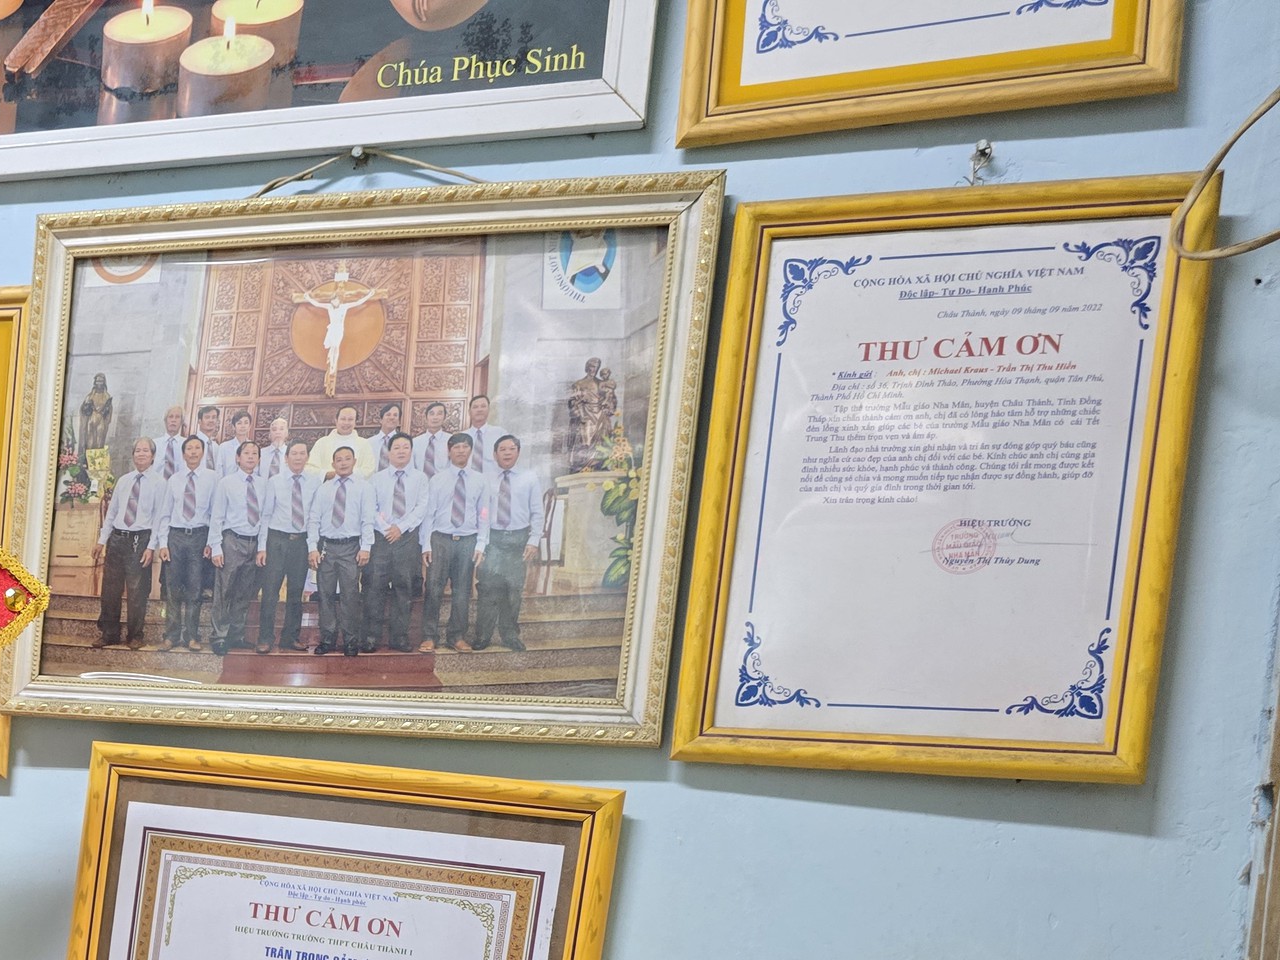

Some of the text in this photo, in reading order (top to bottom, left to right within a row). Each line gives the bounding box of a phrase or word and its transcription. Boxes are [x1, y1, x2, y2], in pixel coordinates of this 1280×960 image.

[376, 44, 586, 88] Chúa Phục Sinh
[853, 266, 1084, 288] CỘNG HÒA XÃ HỘI CHỦ NGHĨA VIỆT NAM
[899, 290, 918, 300] Độc
[941, 287, 955, 298] Tự
[1007, 283, 1032, 294] Phúc
[936, 303, 1103, 318] Châu Thành, ngày 09 tháng 09 năm 2022
[858, 331, 1063, 361] THƯ CẢM ƠN
[837, 371, 857, 380] Kính
[886, 369, 905, 377] Anh,
[928, 367, 962, 375] Michael
[996, 363, 1016, 372] Trần
[1019, 364, 1034, 372] Thị
[1036, 363, 1052, 371] Thu
[1054, 361, 1076, 370] Hiền
[959, 517, 1031, 528] HIỆU TRƯỞNG
[1016, 556, 1040, 566] Dung
[259, 879, 278, 887] CỘNG
[308, 885, 321, 893] HỘI
[322, 887, 338, 895] CHỦ
[338, 889, 361, 897] NGHĨA
[364, 892, 380, 900] VIỆT
[382, 894, 400, 902] NAM
[249, 902, 402, 937] THƯ CẢM ƠN
[234, 925, 254, 934] HIỆU
[256, 928, 289, 938] TRƯỞNG
[292, 933, 325, 943] TRƯỜNG
[327, 938, 349, 947] THPT
[350, 941, 375, 950] CHÂU
[377, 945, 407, 955] THÀNH
[265, 946, 292, 960] TRÂN
